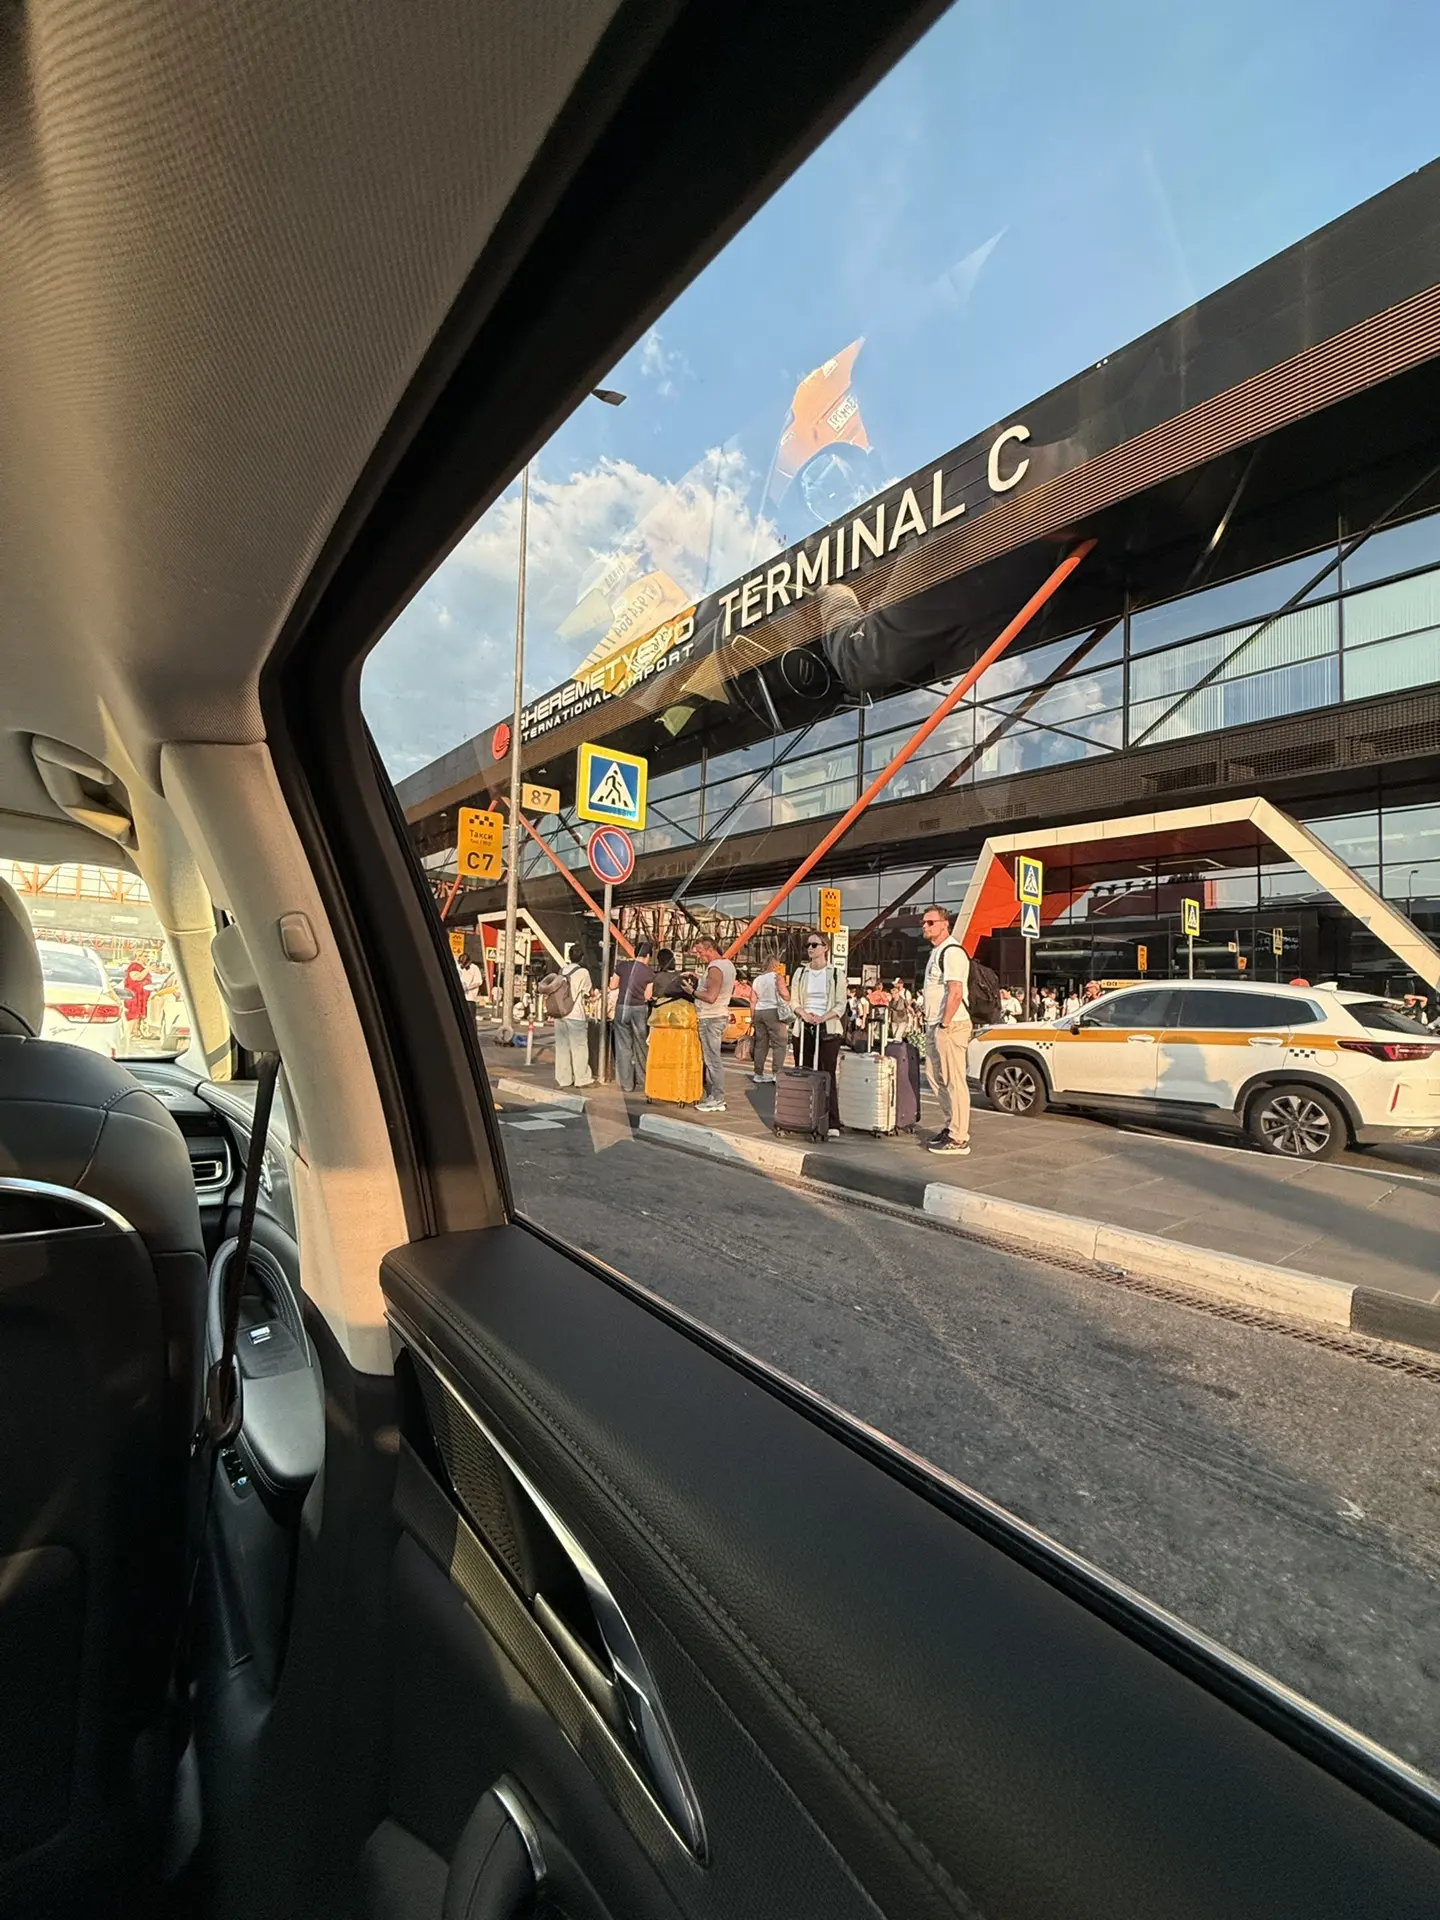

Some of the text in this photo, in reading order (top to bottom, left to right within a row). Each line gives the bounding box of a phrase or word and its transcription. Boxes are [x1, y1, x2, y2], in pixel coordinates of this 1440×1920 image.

[718, 425, 1030, 637] TERMINAL C
[531, 789, 552, 806] 87
[469, 829, 494, 841] Такси
[467, 852, 494, 871] C7
[825, 916, 837, 928] C6
[836, 944, 846, 952] C5
